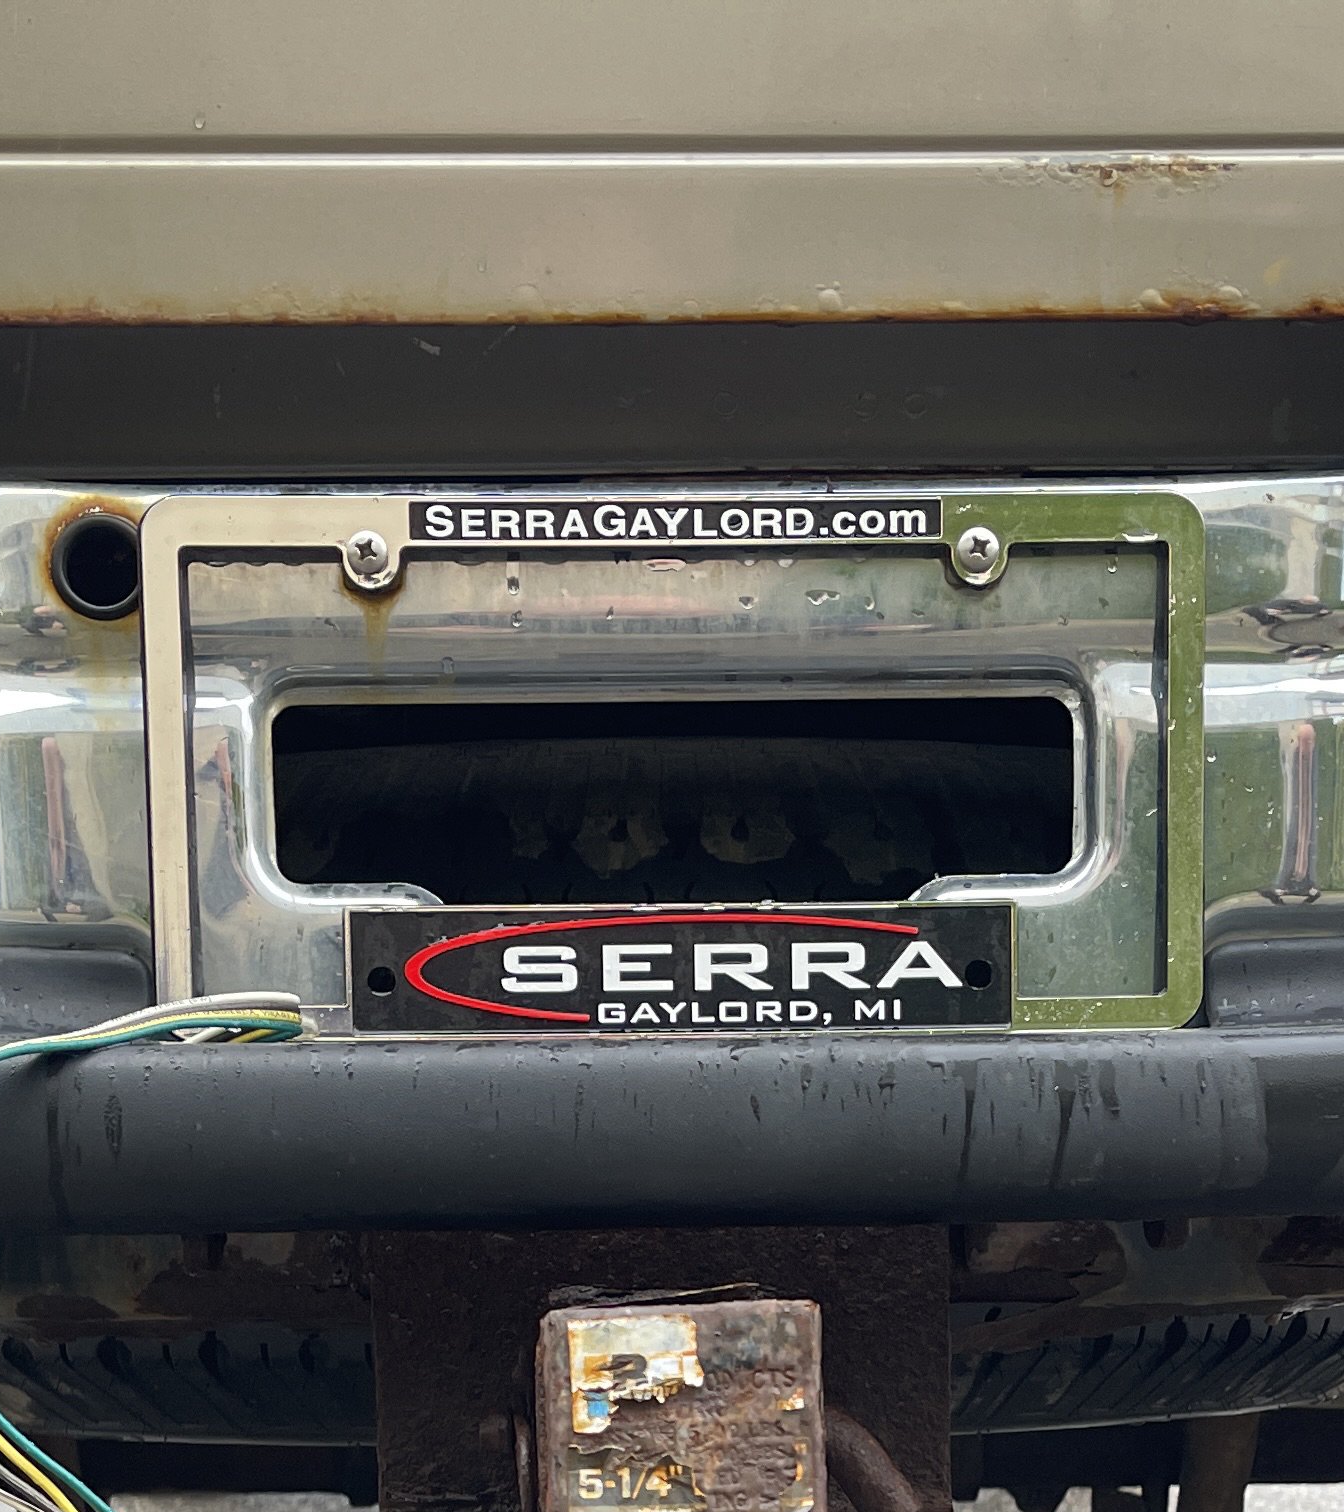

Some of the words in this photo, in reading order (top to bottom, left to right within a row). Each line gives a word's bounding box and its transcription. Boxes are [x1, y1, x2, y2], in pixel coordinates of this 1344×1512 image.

[424, 504, 928, 538] SERRAGAYLORD.com
[500, 940, 965, 993] SERRA
[597, 999, 834, 1025] GAYLORD,
[854, 997, 902, 1021] MI
